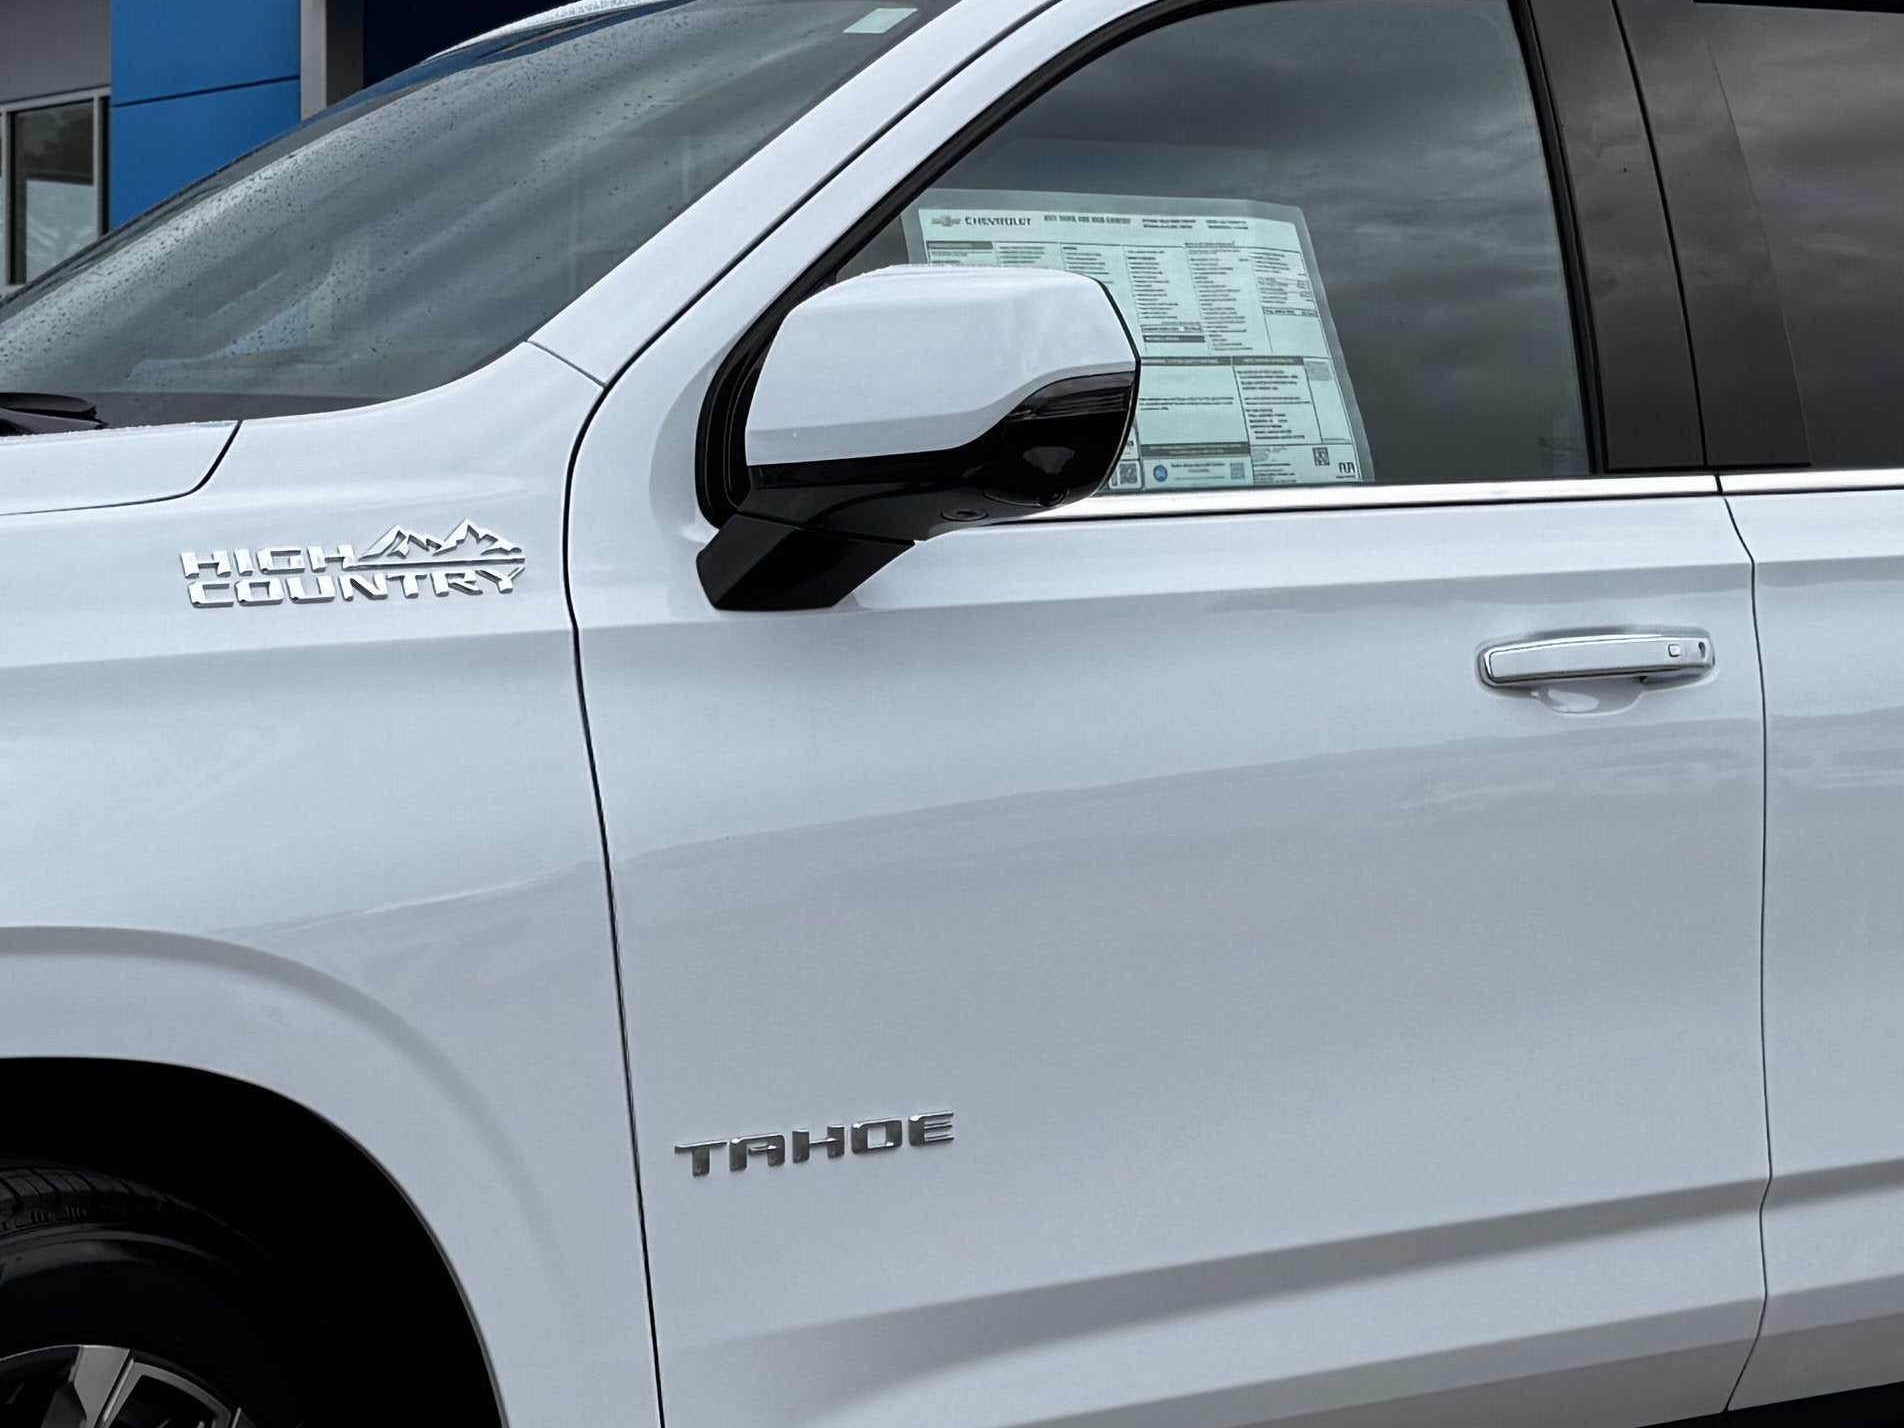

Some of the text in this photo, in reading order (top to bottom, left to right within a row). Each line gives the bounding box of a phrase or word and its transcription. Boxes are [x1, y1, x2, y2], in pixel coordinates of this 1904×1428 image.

[179, 544, 356, 579] HIGH
[188, 566, 526, 608] COUNTRY
[674, 1110, 955, 1178] TAHOE
